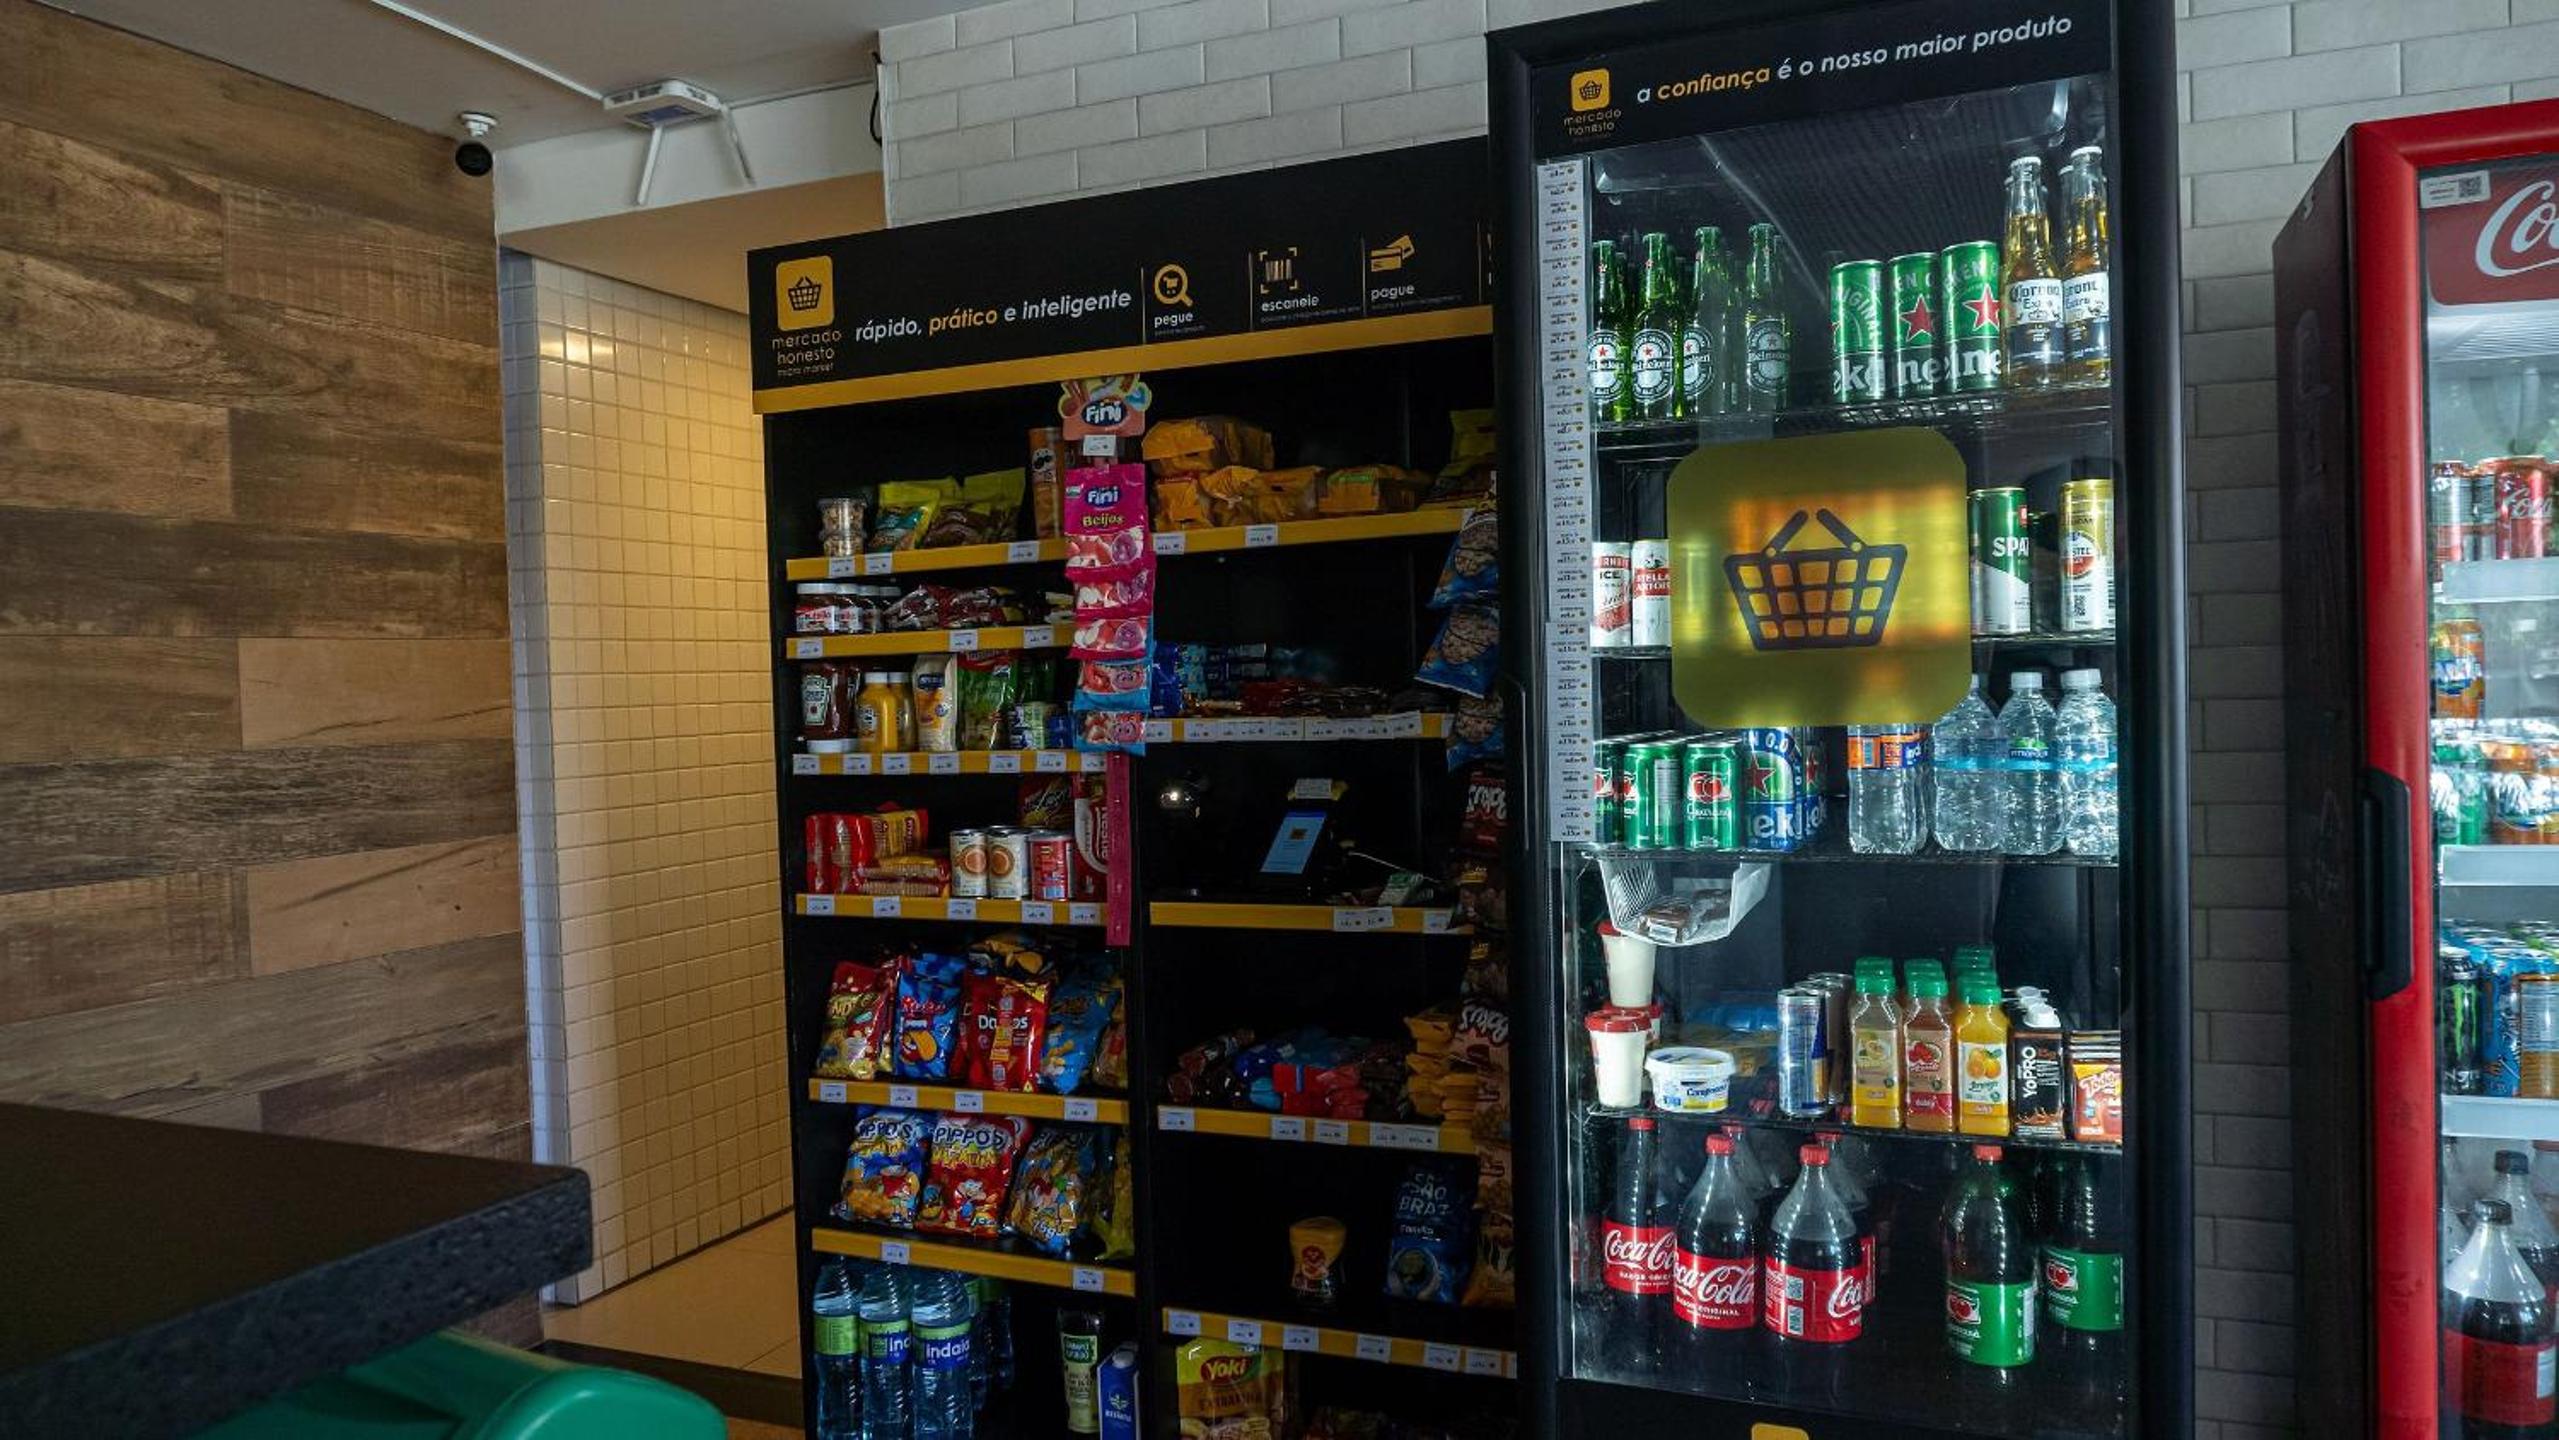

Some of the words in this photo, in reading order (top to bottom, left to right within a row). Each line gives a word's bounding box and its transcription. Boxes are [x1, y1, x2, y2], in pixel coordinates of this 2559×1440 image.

[1637, 87, 1651, 103] a
[1657, 67, 1771, 100] confiança
[1777, 58, 1792, 80] é
[1799, 60, 1814, 76] o
[1821, 49, 1888, 73] nosso
[1895, 34, 1967, 61] maior
[1972, 15, 2073, 53] produto
[1563, 108, 1622, 127] mercado
[1370, 283, 1415, 301] pague
[1261, 294, 1320, 312] escaneie
[855, 316, 923, 343] rápido,
[929, 307, 998, 336] prático
[1003, 306, 1017, 322] e
[1022, 289, 1132, 320] inteligente
[1154, 312, 1194, 329] pegue
[772, 330, 842, 350] mercado
[777, 347, 835, 366] honesto
[2021, 1046, 2039, 1098] YoPRO
[1205, 1358, 1247, 1381] Yoki
